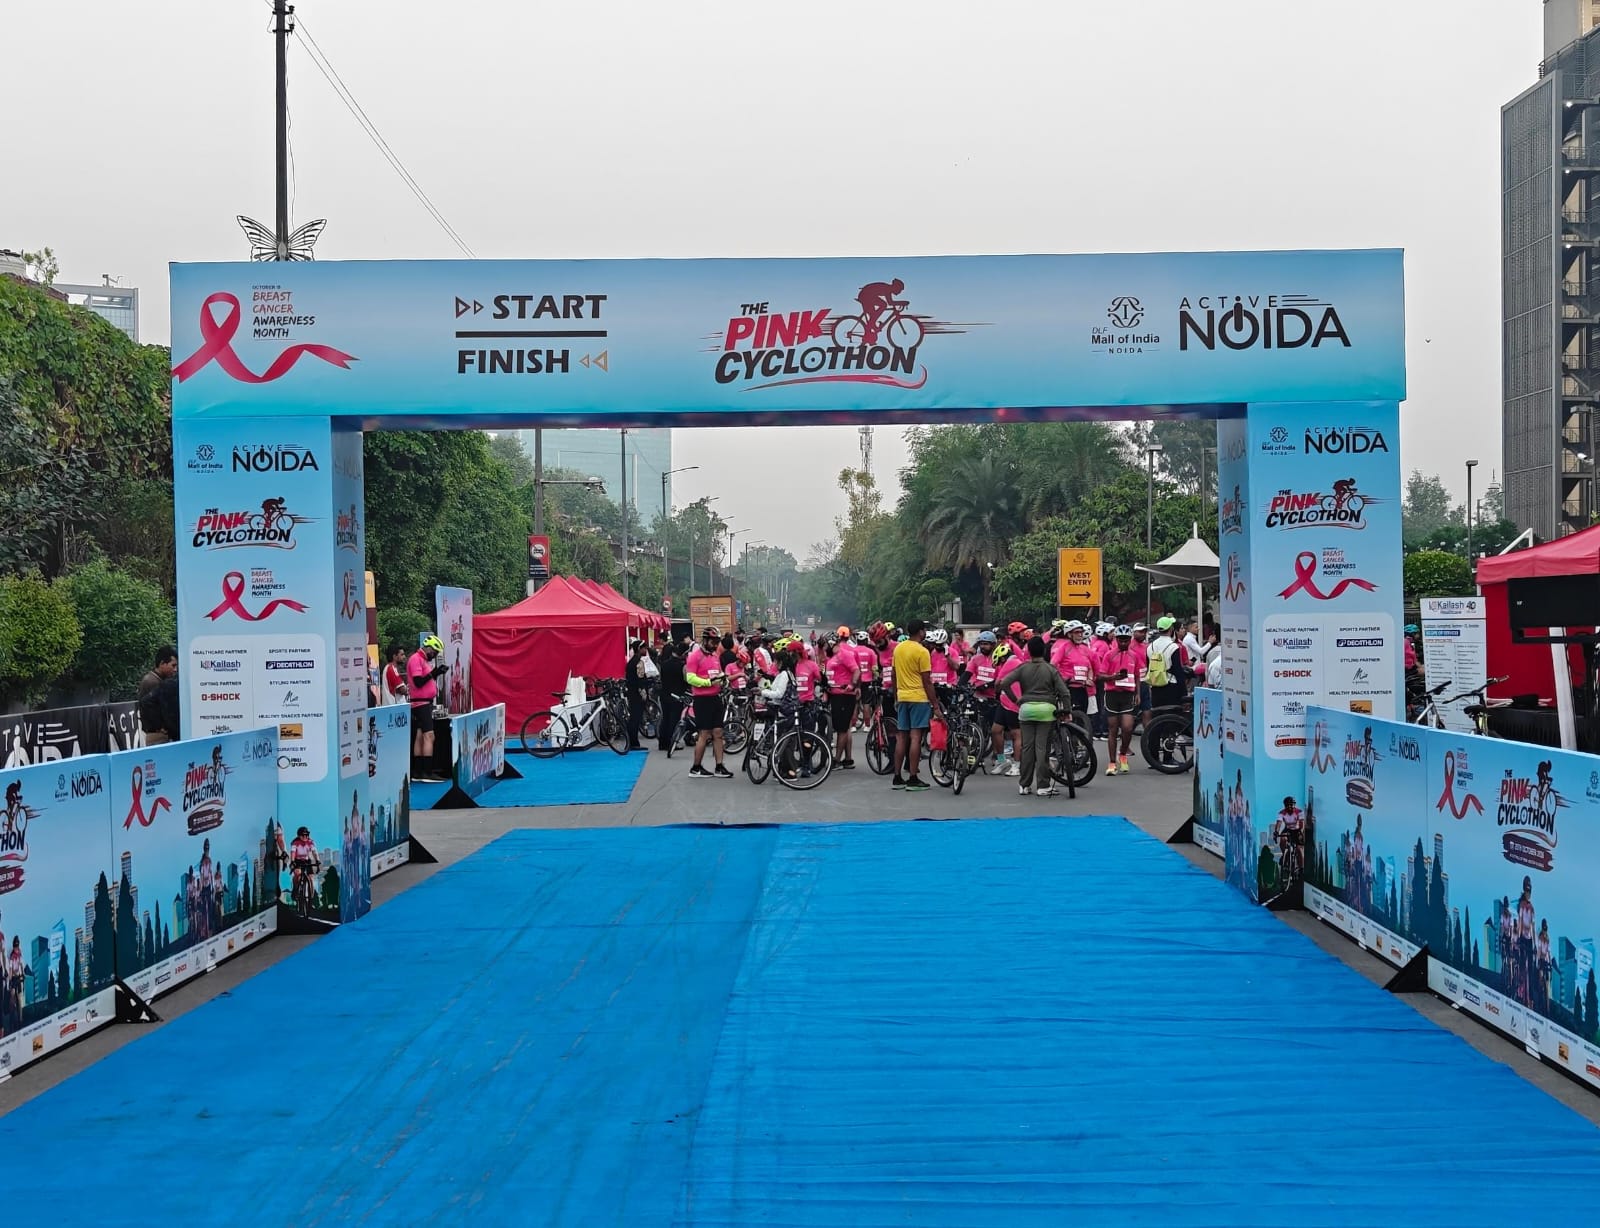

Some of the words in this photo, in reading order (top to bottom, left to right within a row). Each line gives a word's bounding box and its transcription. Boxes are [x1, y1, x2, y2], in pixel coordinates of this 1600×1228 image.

[252, 292, 293, 302] BREAST
[492, 294, 608, 320] START
[252, 304, 294, 314] CANCER
[740, 302, 770, 316] THE
[252, 316, 316, 327] AWARENESS
[724, 308, 832, 352] PINK
[1092, 326, 1109, 335] DLF
[1179, 307, 1352, 351] NOIDA
[253, 328, 289, 338] MONTH
[1091, 334, 1114, 344] Mall
[1118, 334, 1130, 344] of
[1132, 333, 1160, 344] India
[458, 349, 570, 374] FINISH
[714, 346, 918, 384] CYCLOTHON
[1304, 432, 1388, 454] NOIDA
[232, 451, 319, 472] NOIDA
[1270, 493, 1321, 512] PINK
[197, 510, 248, 531] PINK
[1266, 510, 1362, 528] CYCLOTHON
[192, 528, 292, 548] CYCLOTHON
[1282, 638, 1312, 646] Kailash
[210, 660, 240, 669] Kailash
[1398, 740, 1420, 763] NOIDA
[185, 763, 208, 792] PINK
[1504, 769, 1512, 778] THE
[71, 774, 102, 799] NOIDA
[182, 782, 224, 812] CYCLOTHON
[1500, 778, 1530, 804] PINK
[1497, 804, 1556, 836] CYCLOTHON
